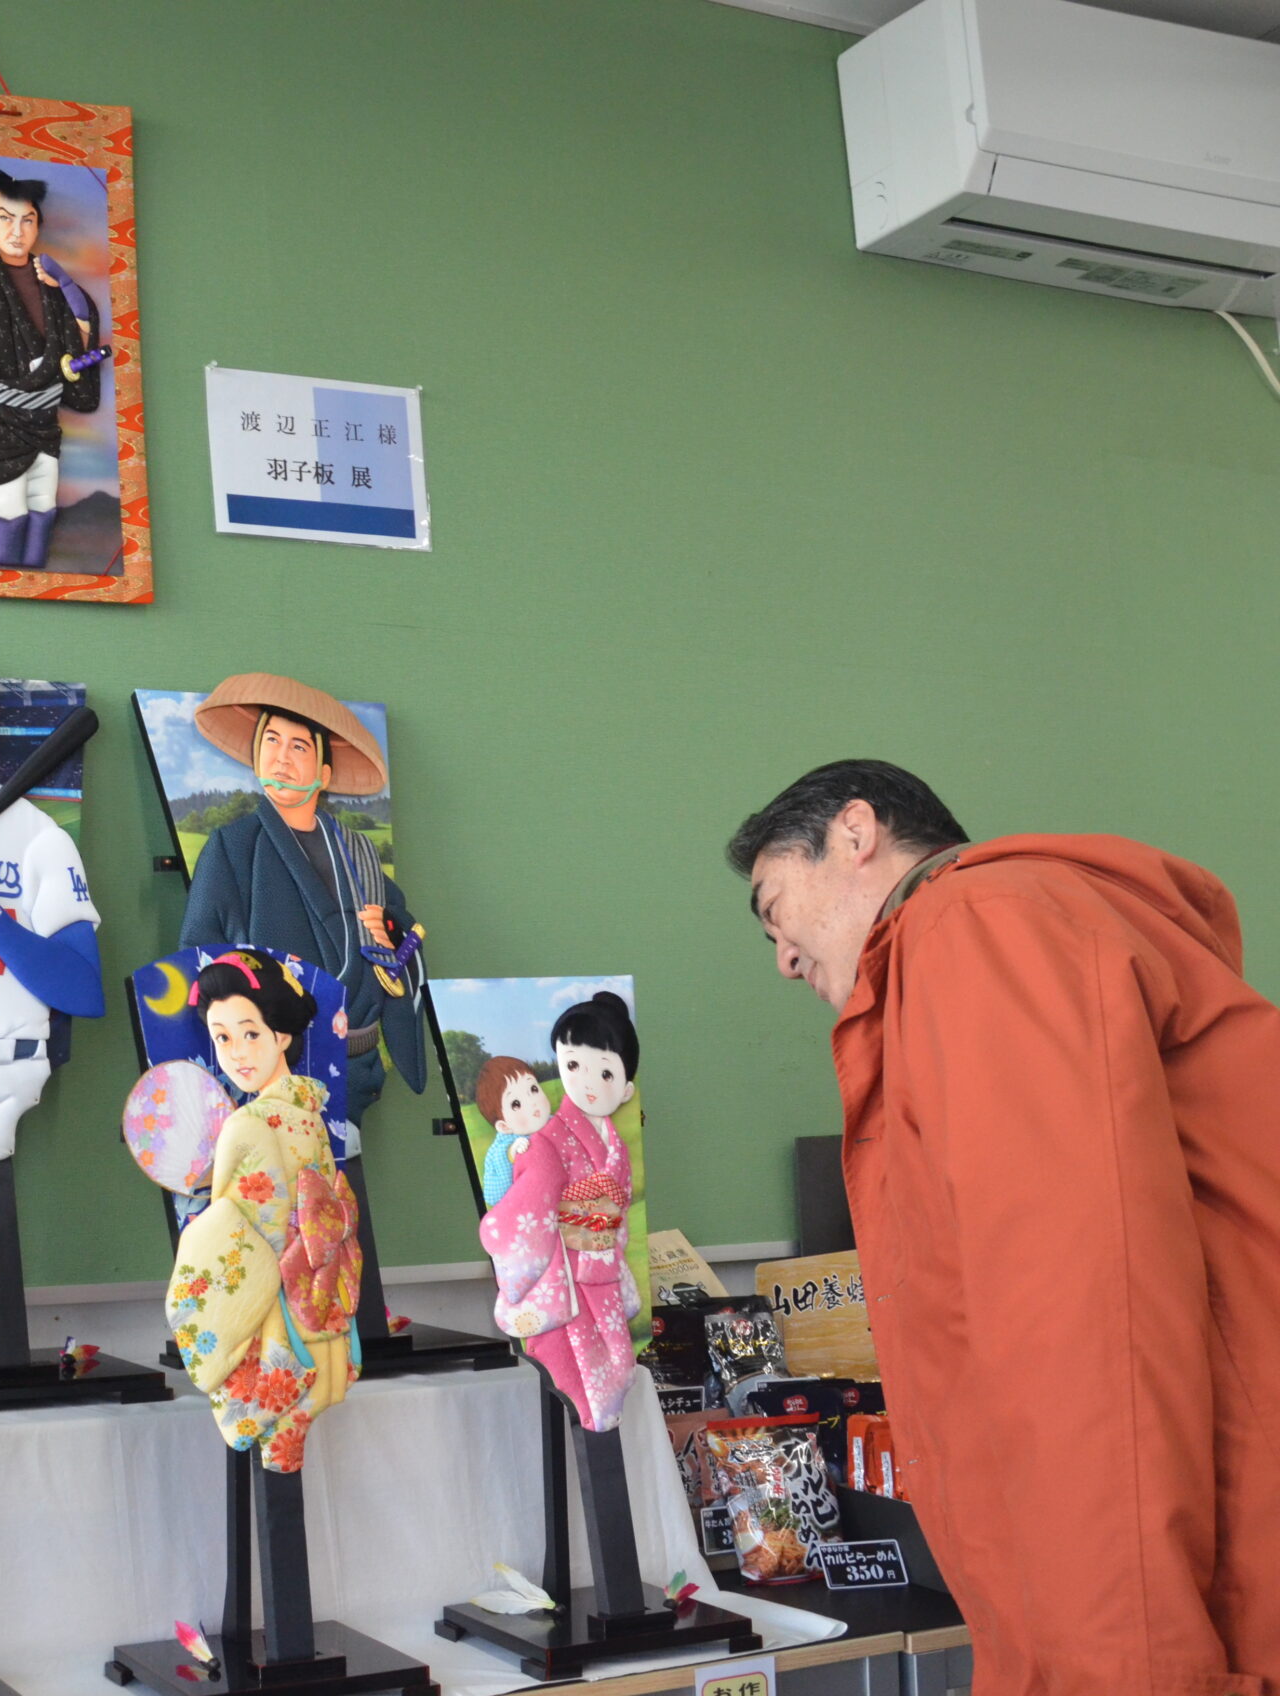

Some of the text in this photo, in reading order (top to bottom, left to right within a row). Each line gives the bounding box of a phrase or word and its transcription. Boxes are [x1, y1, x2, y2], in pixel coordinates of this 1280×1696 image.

[240, 411, 397, 445] 渡辺正江様
[67, 867, 89, 902] LA
[824, 1550, 896, 1566] カルビらーめん
[846, 1564, 896, 1581] 350 円
